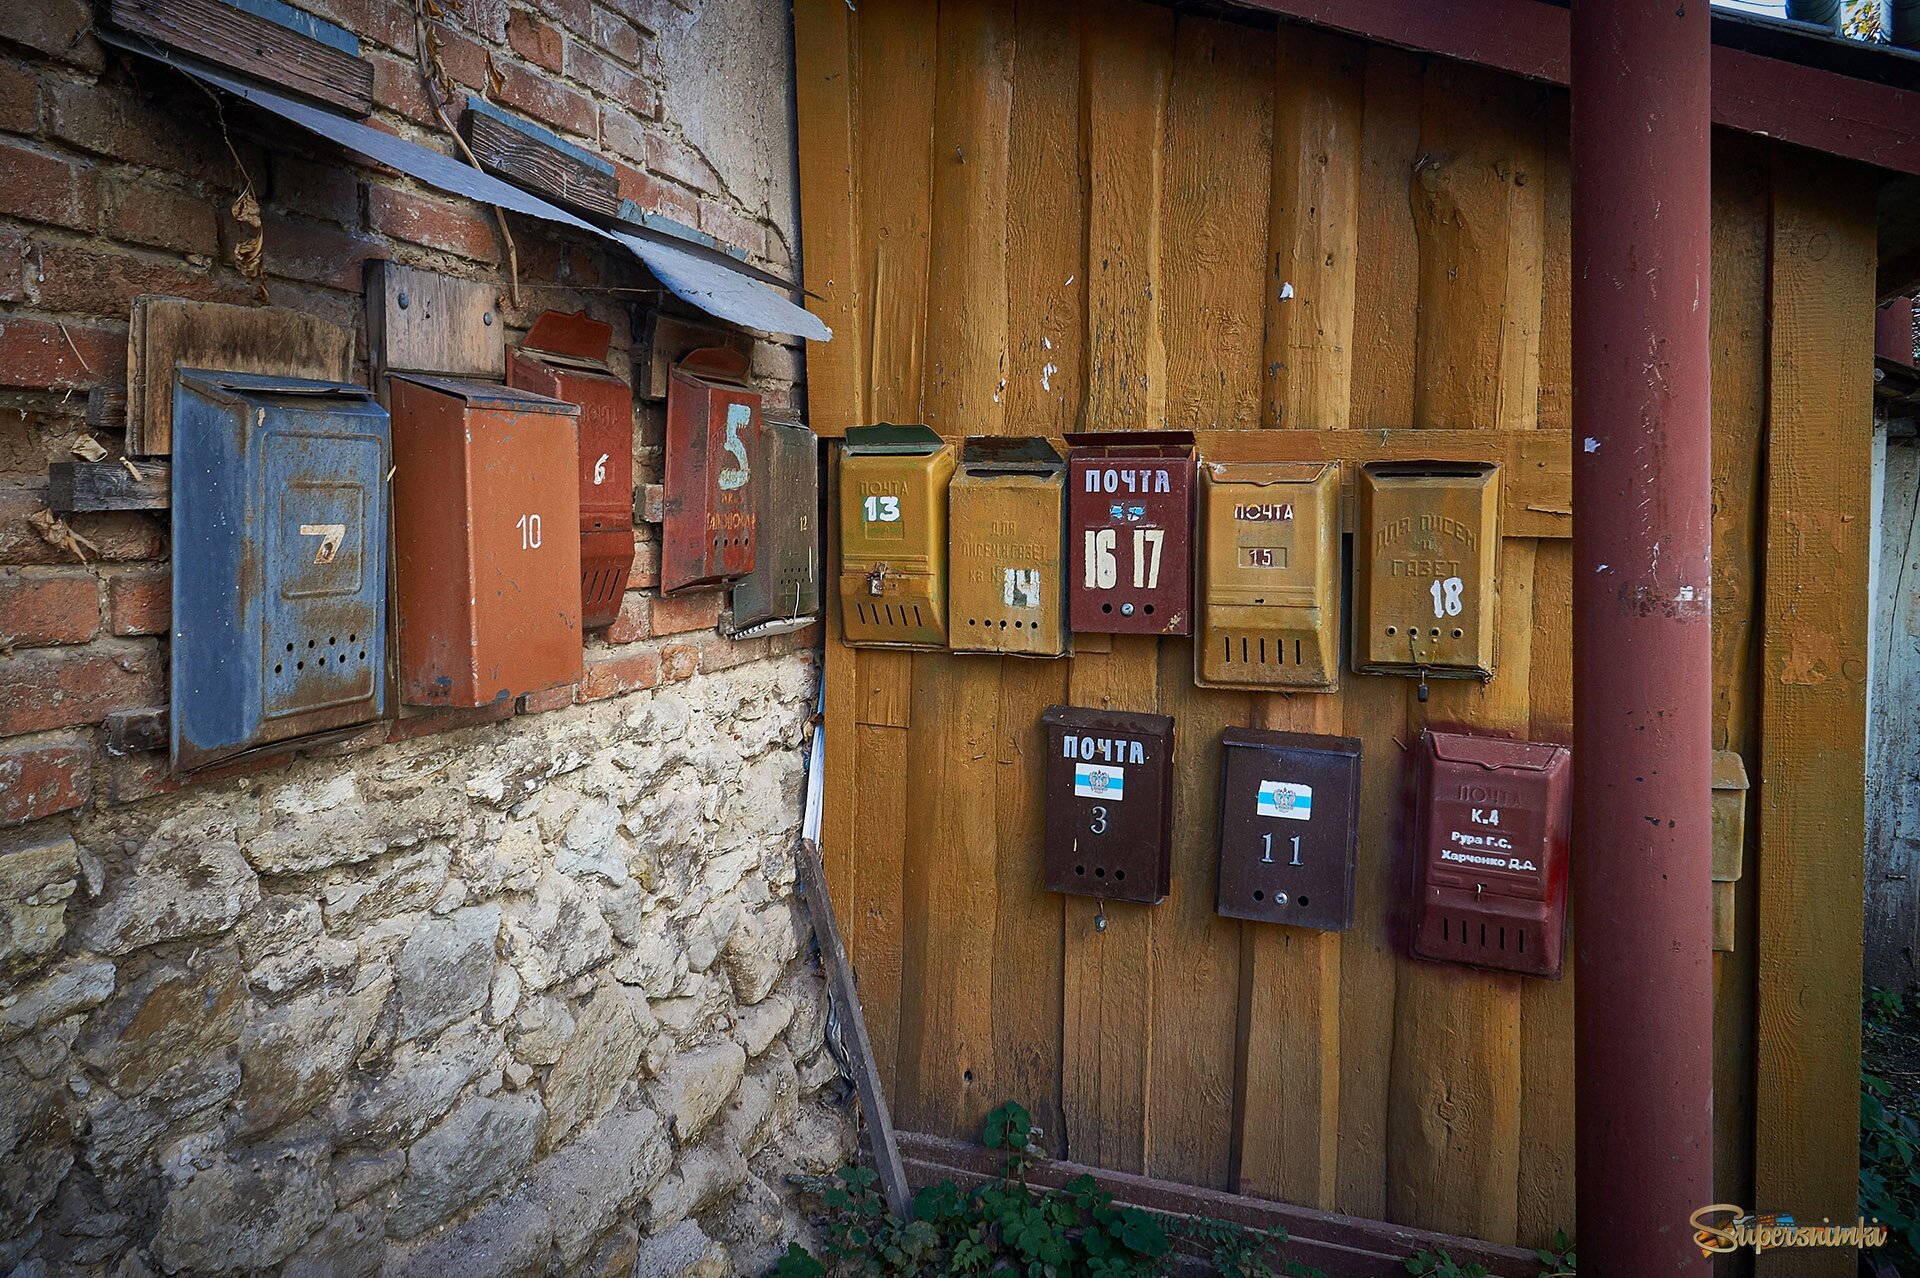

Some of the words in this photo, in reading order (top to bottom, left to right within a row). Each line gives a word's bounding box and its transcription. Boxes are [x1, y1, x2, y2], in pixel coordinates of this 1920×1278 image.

[718, 403, 750, 490] 5
[594, 453, 610, 485] 6
[1085, 469, 1171, 493] ПОЧТА
[860, 481, 909, 495] ПОЧТА
[864, 496, 900, 521] 13
[1234, 504, 1293, 519] ПОЧТА
[516, 514, 542, 550] 10
[800, 515, 808, 531] 12
[1420, 514, 1477, 552] ПИСЕМ
[300, 524, 346, 564] 7
[1250, 548, 1272, 566] 15
[1085, 529, 1117, 589] 16
[1133, 529, 1165, 589] 17
[1391, 560, 1460, 576] ГАЗЕТ
[1004, 568, 1040, 606] 14
[1430, 577, 1463, 618] 18
[1063, 735, 1145, 764] ПОЧТА
[1090, 806, 1108, 834] 3
[1451, 831, 1483, 845] Рура
[1486, 836, 1512, 849] Г.С.
[1441, 849, 1506, 867] Харченко
[1508, 858, 1537, 871] Д.А.
